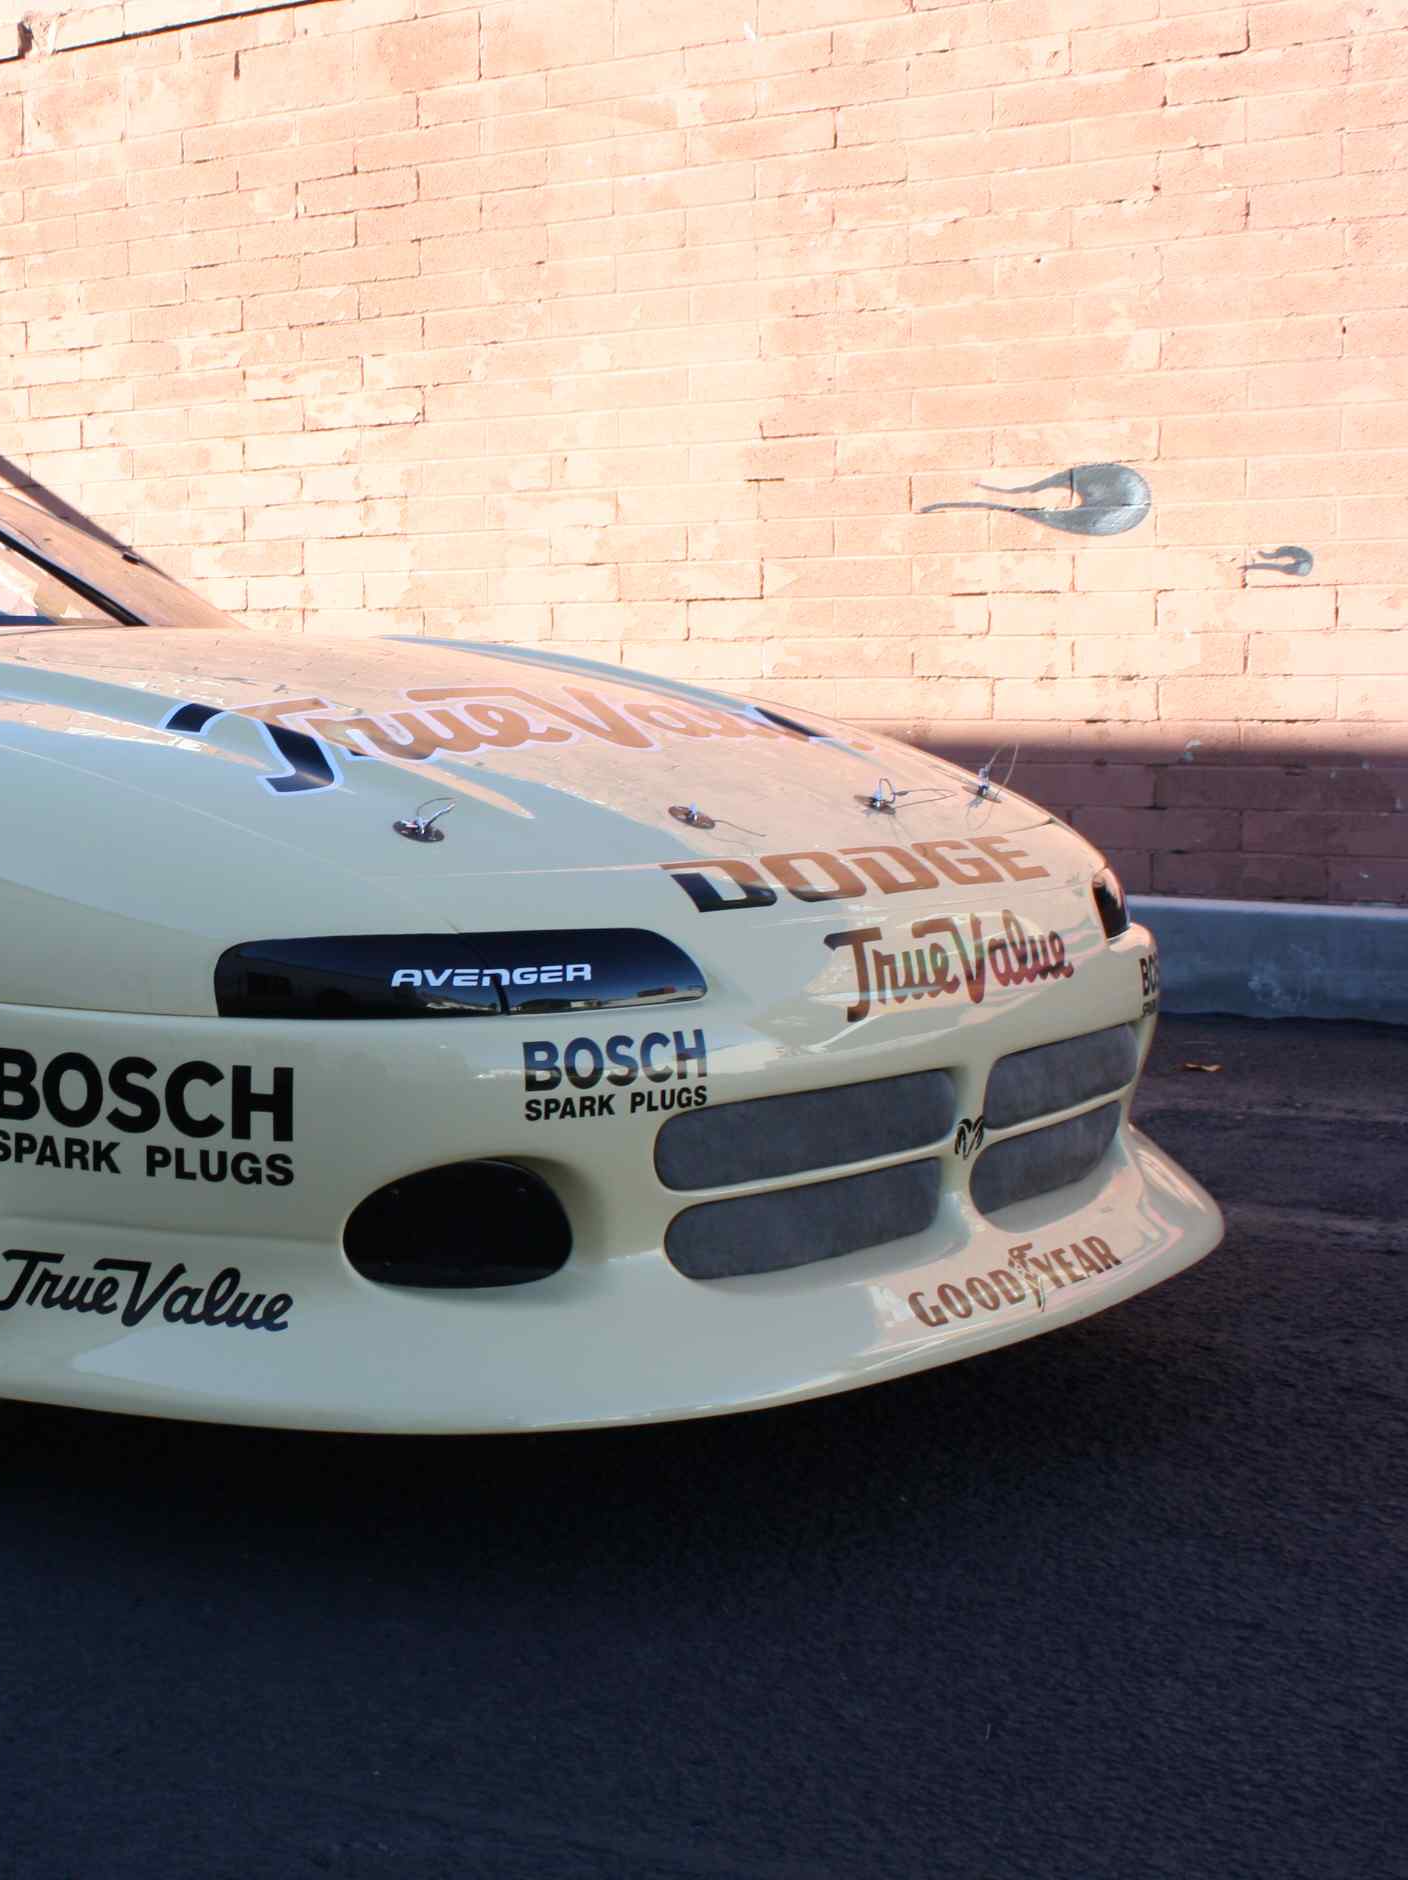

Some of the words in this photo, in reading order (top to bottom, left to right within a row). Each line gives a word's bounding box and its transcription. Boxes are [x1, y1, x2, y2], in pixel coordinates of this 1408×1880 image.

[657, 835, 1051, 913] DODGE
[391, 963, 593, 988] AVENGER
[523, 1028, 708, 1092] BOSCH
[525, 1094, 616, 1122] SPARK
[629, 1085, 708, 1114] PLUGS
[145, 1144, 295, 1187] PLUGS
